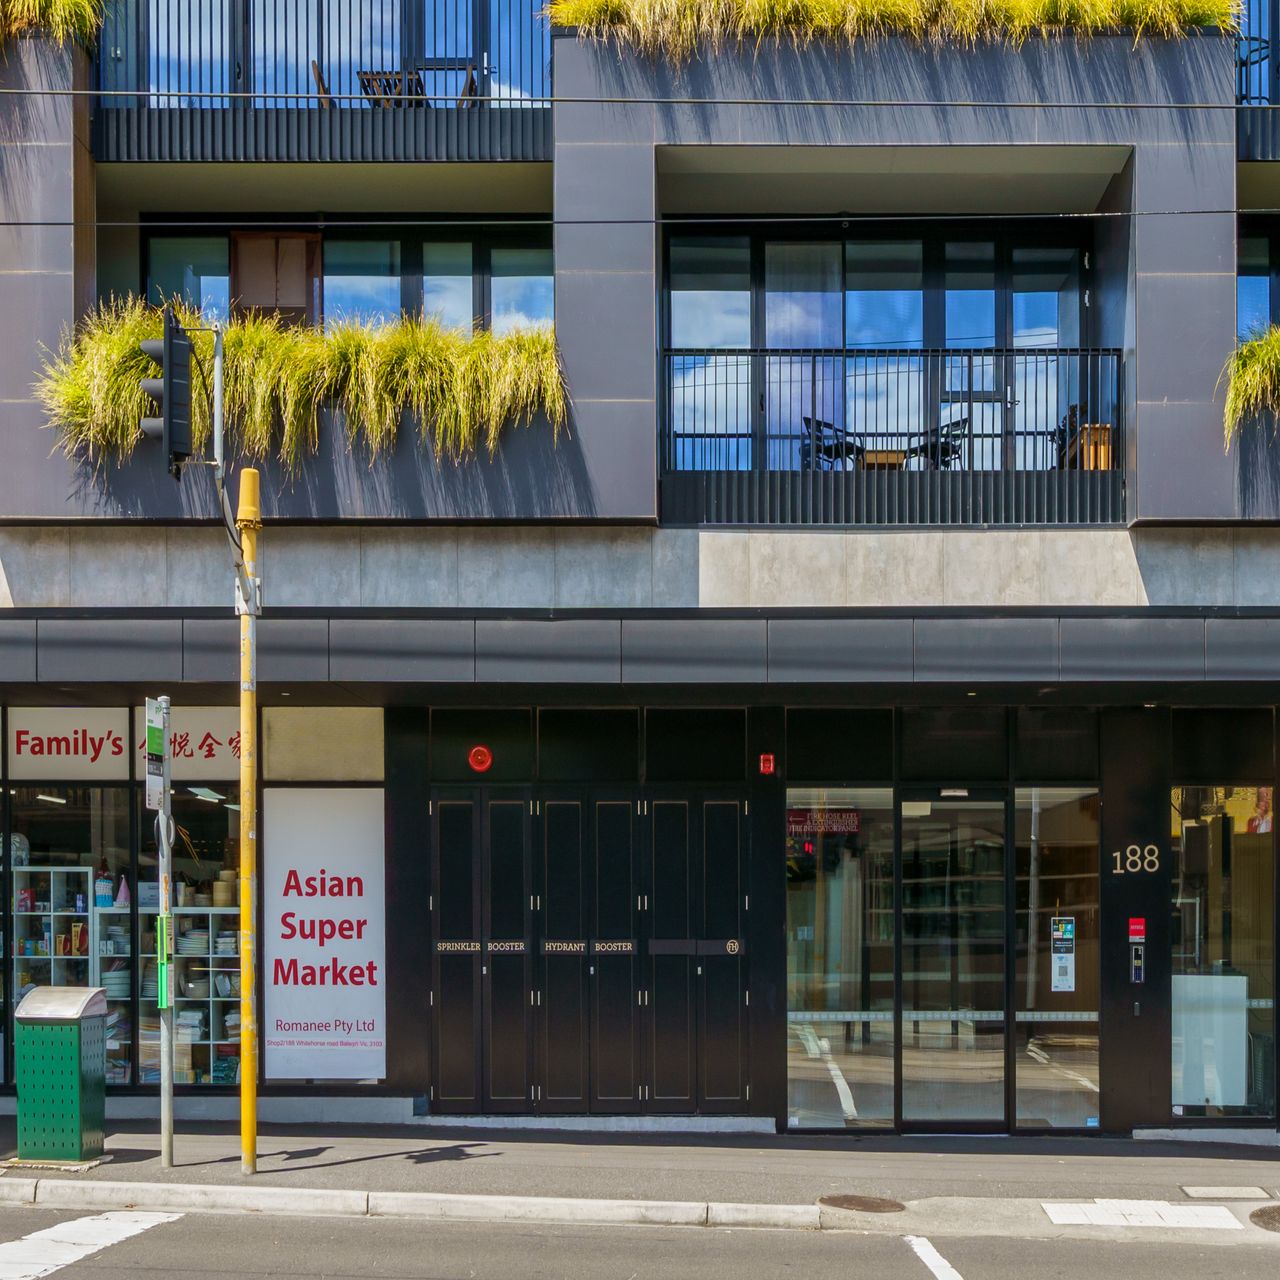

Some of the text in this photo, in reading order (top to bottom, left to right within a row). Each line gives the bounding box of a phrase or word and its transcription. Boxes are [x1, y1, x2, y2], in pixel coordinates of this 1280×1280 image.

[1113, 845, 1160, 874] 188
[283, 869, 364, 897] Asian
[281, 912, 367, 947] Super
[437, 942, 525, 951] SPRINKLER BOOSTER
[545, 942, 633, 951] HYDRANT BOOSTER
[273, 957, 377, 986] Market
[276, 1018, 375, 1035] Romanee Pty Ltd
